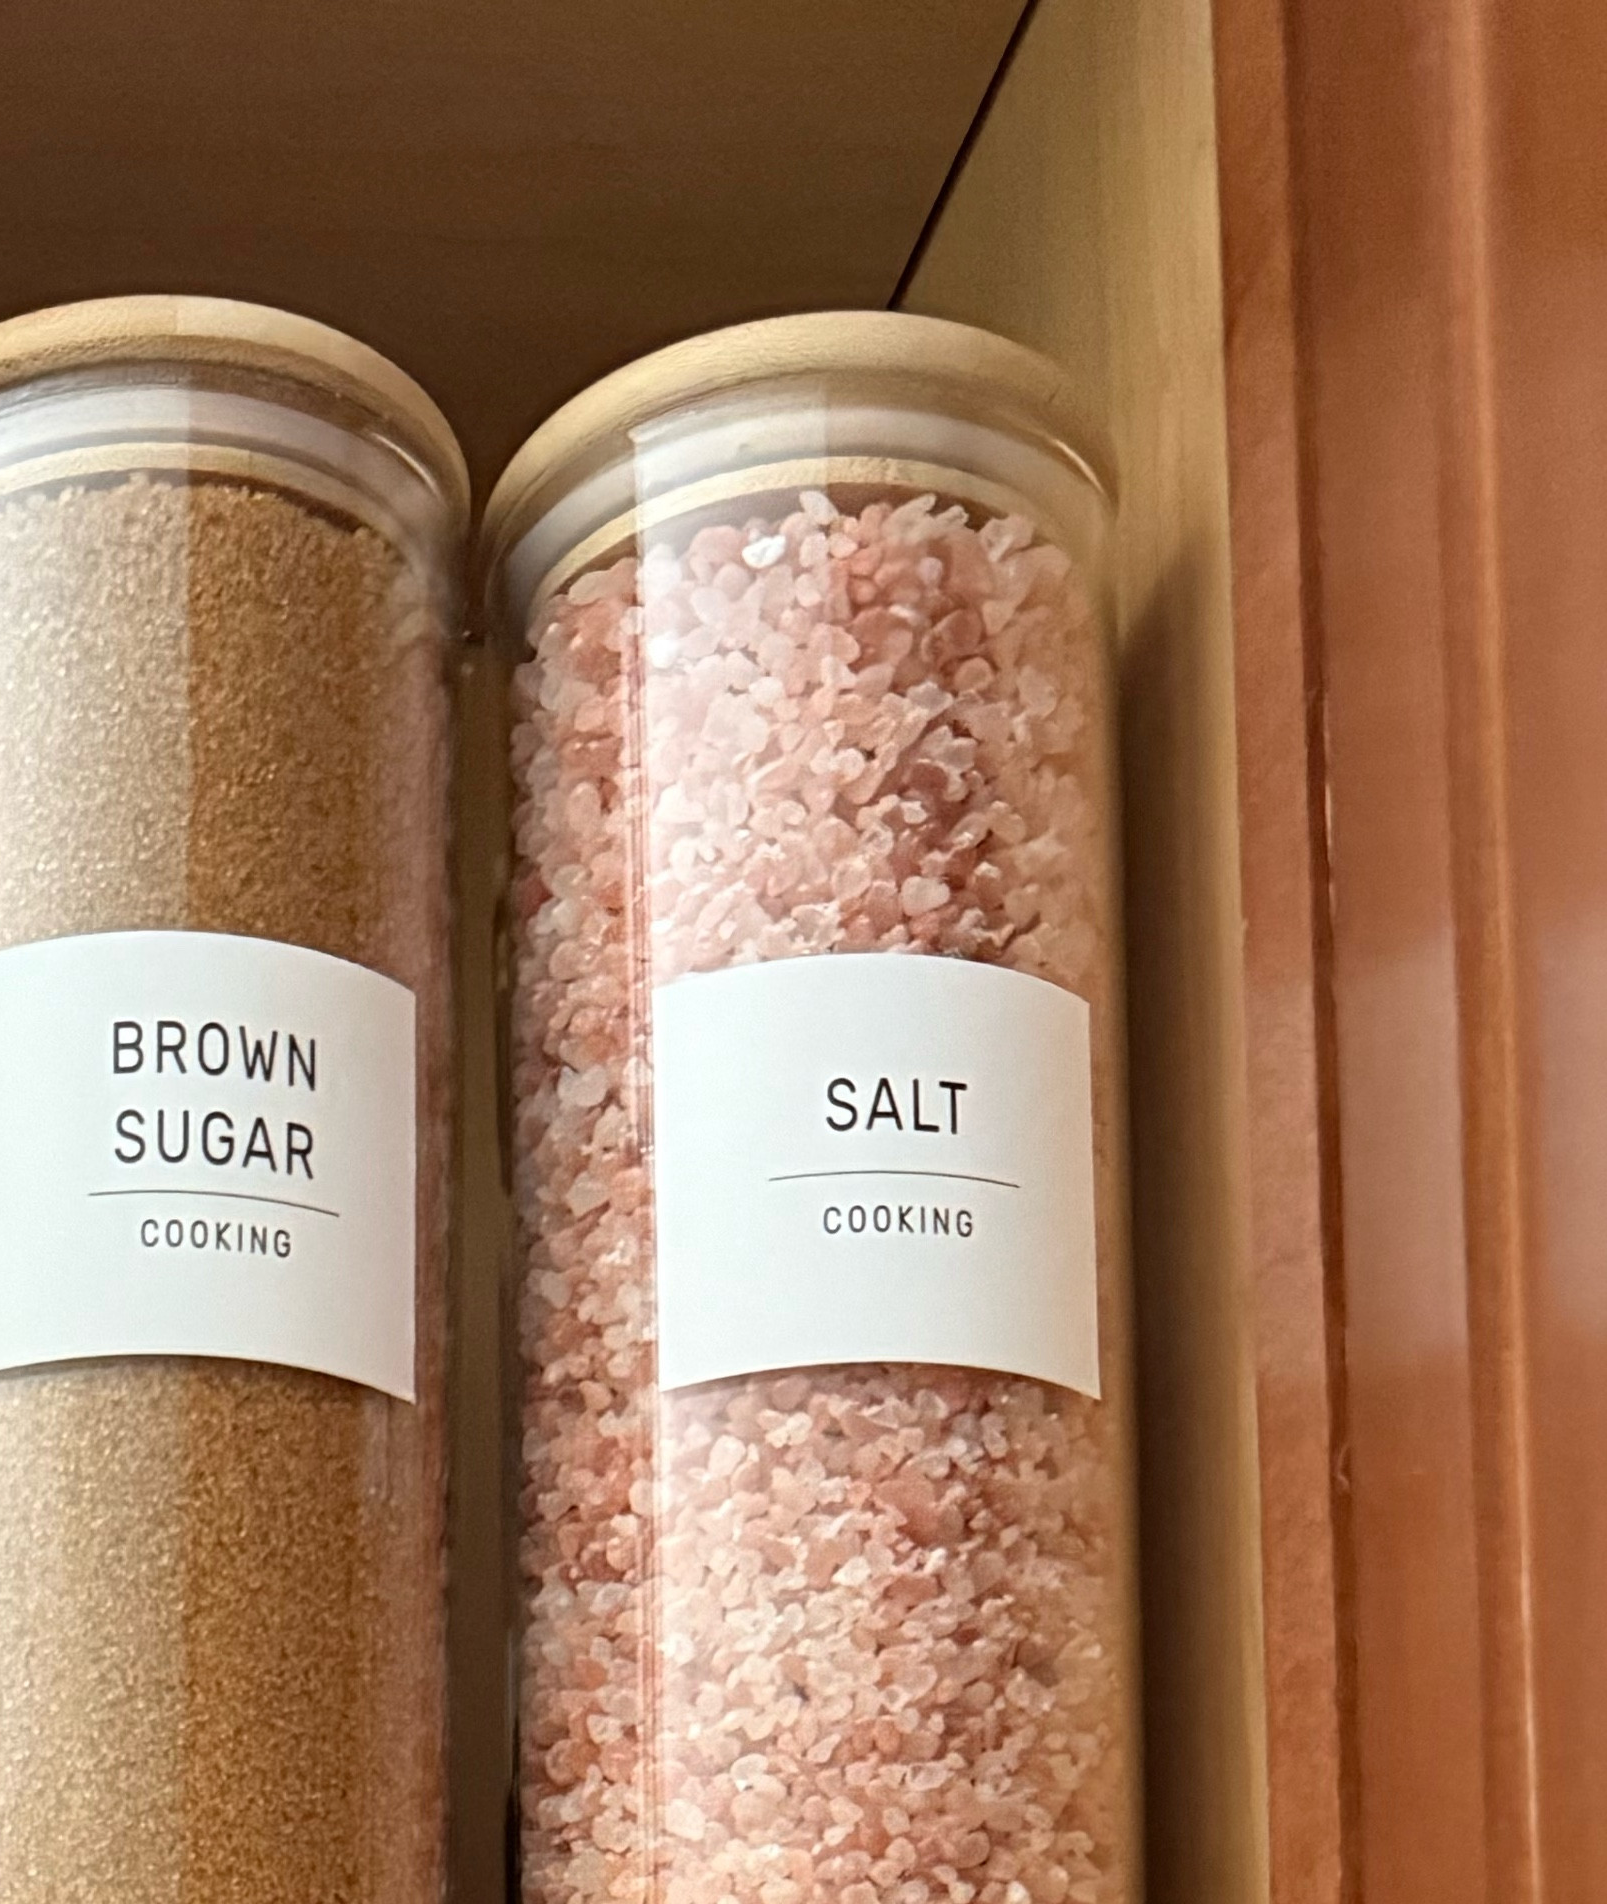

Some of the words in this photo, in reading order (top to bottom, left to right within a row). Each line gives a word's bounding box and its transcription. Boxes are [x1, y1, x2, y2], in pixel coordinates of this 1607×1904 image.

[113, 1020, 317, 1092] BROWN
[826, 1077, 968, 1135] SALT
[114, 1109, 314, 1180] SUGAR
[140, 1218, 292, 1259] COOKING
[823, 1204, 974, 1239] COOKING
